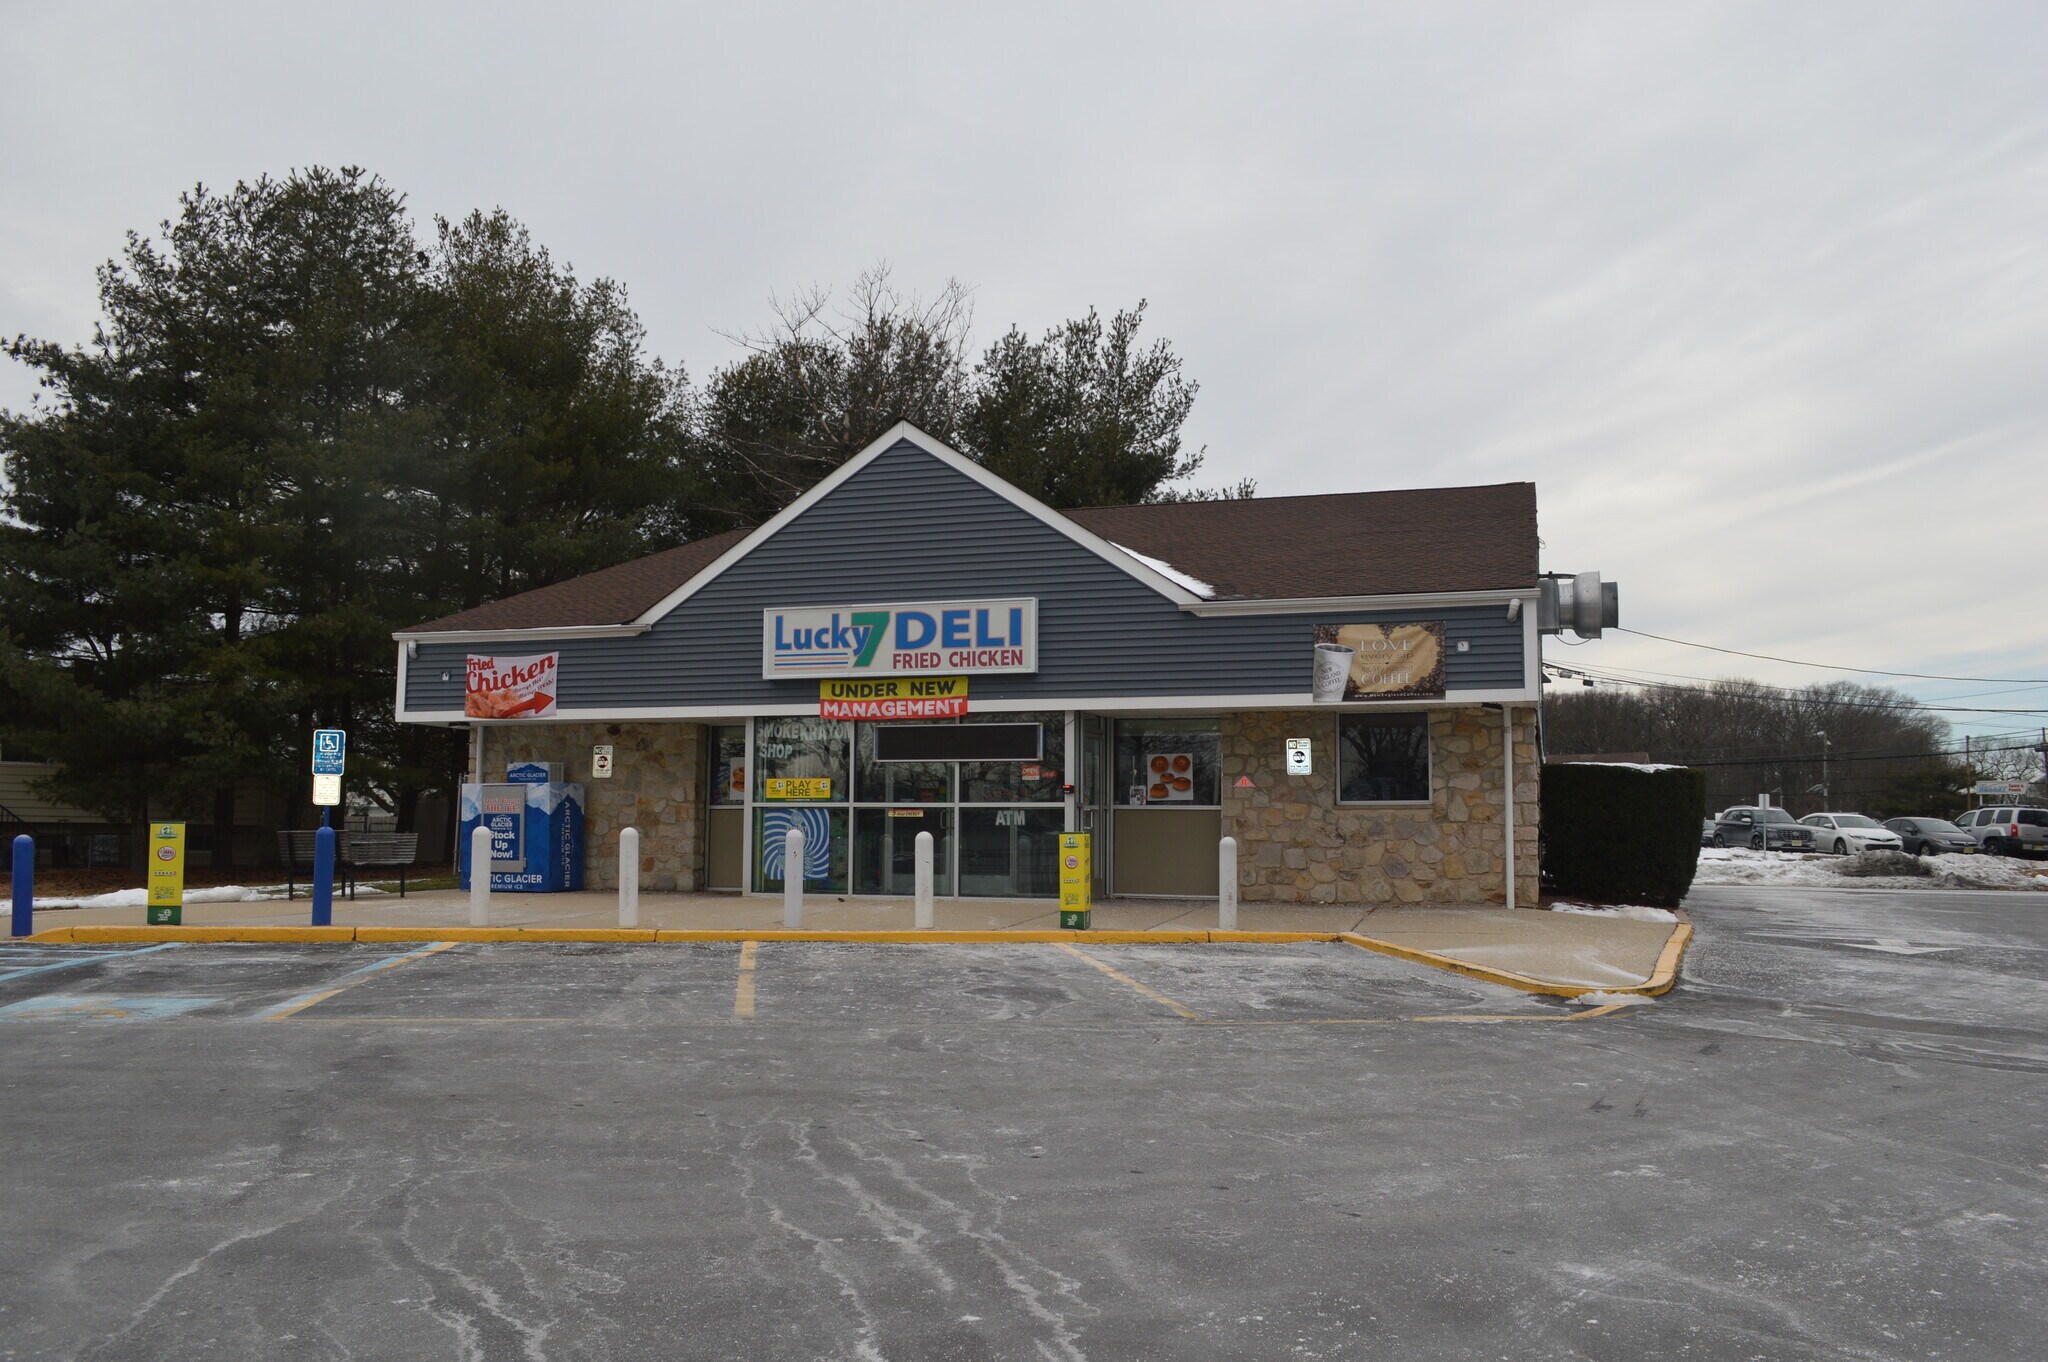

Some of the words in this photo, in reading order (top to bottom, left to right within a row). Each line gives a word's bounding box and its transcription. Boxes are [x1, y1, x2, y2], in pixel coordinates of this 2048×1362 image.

[774, 613, 872, 656] Lucky
[851, 610, 891, 668] 7
[894, 607, 1023, 651] DELI
[1361, 639, 1413, 652] LOVE
[467, 657, 495, 671] Fried
[892, 652, 942, 669] FRIED
[949, 649, 1023, 668] CHICKEN
[466, 655, 555, 694] Chicken
[1361, 672, 1413, 685] COFFEE
[1321, 677, 1341, 687] COFFEE
[830, 682, 898, 699] UNDER
[910, 680, 957, 695] NEW
[823, 698, 963, 717] MANAGEMENT
[758, 723, 799, 739] SMOKE
[1288, 740, 1297, 749] NO
[759, 744, 793, 759] SHOP
[785, 780, 811, 789] PLAY
[785, 788, 811, 797] HERE
[485, 804, 503, 812] THE
[995, 810, 1026, 826] ATM
[490, 831, 515, 839] Stock
[494, 841, 508, 850] Up
[490, 850, 513, 858] Now!
[504, 874, 543, 884] GLACIER
